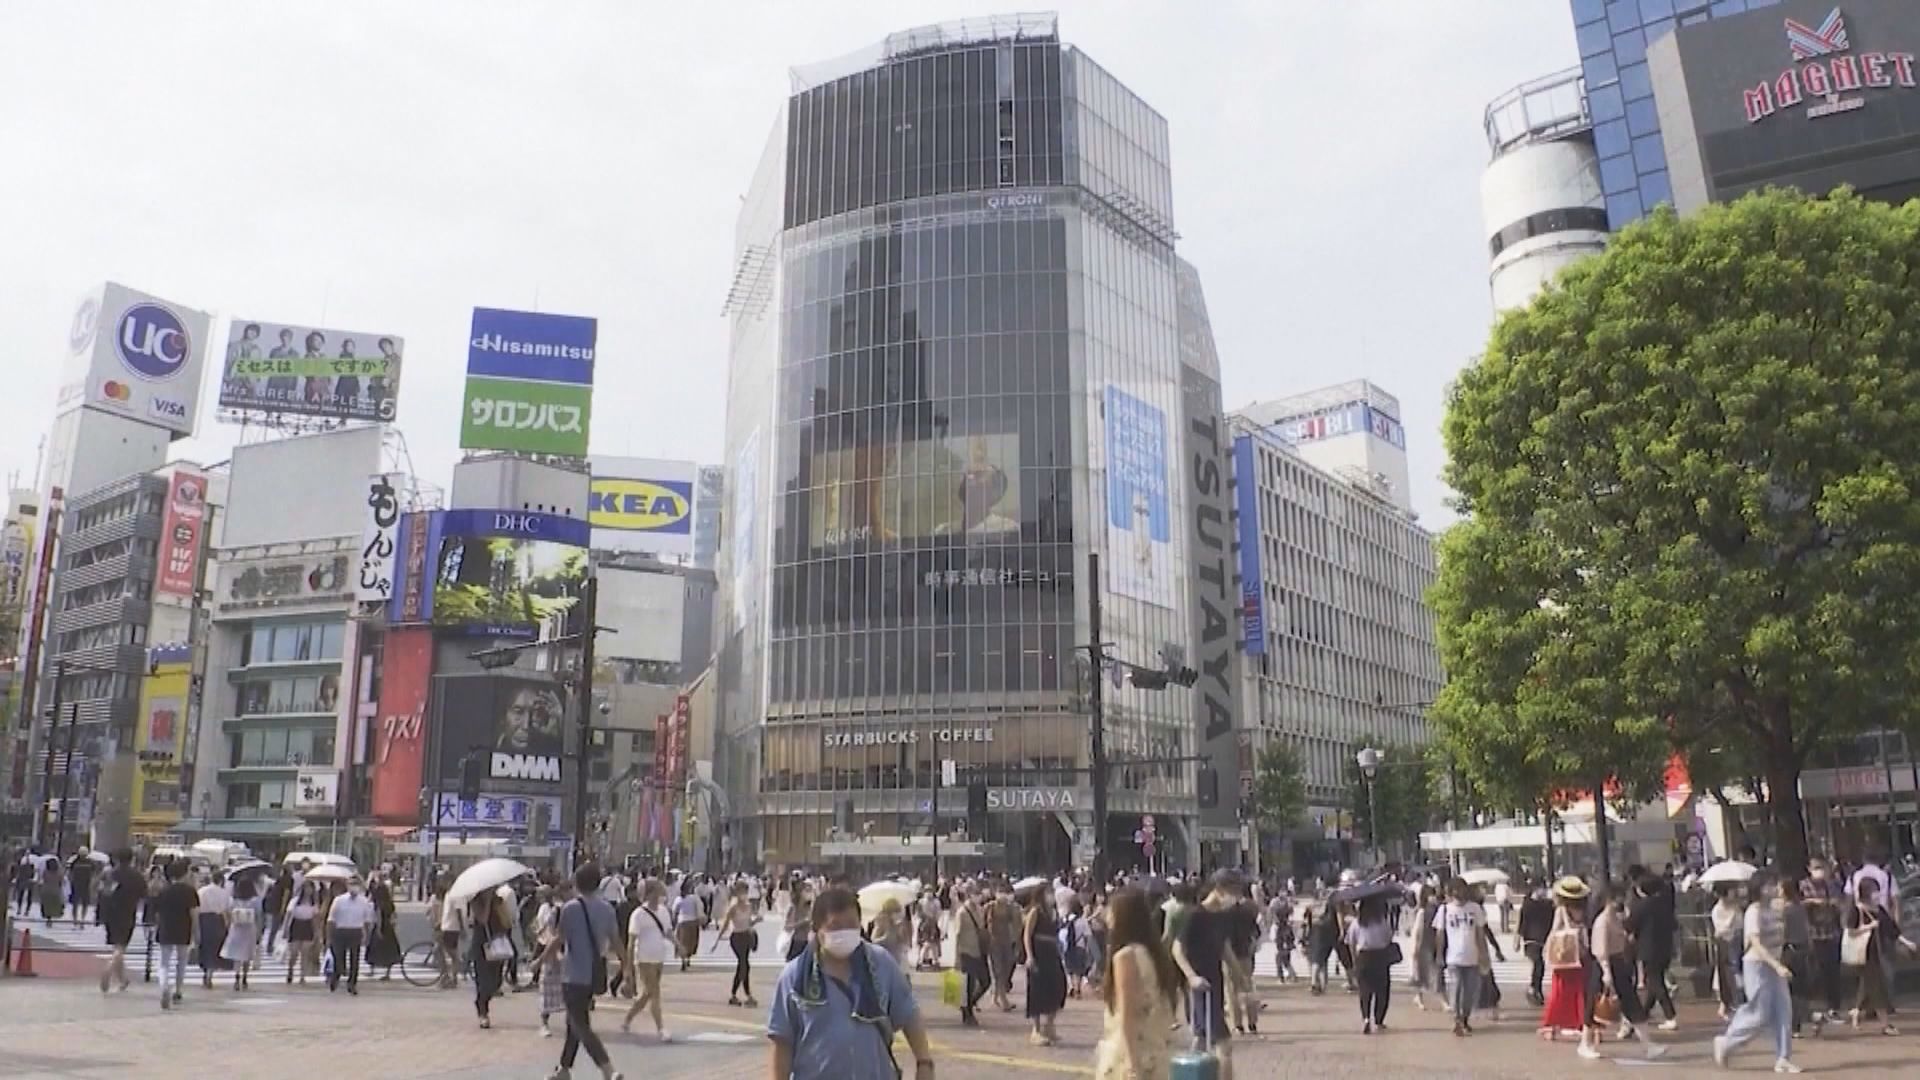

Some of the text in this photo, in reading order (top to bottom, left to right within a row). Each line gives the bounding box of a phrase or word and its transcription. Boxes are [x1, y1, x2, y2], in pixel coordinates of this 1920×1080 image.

[1744, 52, 1916, 121] MAGNET
[124, 315, 186, 363] UC
[471, 333, 594, 360] Hisamitsu
[154, 398, 185, 417] VISA
[379, 398, 395, 419] 5
[471, 397, 582, 433] サロンパス
[589, 491, 681, 517] KEA
[359, 474, 399, 597] もんじゃ
[494, 513, 541, 532] DHC
[1192, 414, 1232, 742] TSUTAYA
[824, 731, 919, 747] STARBUCKS
[490, 751, 561, 781] DMM
[439, 797, 558, 826] 大盛堂書
[986, 790, 1075, 808] SUTAYA
